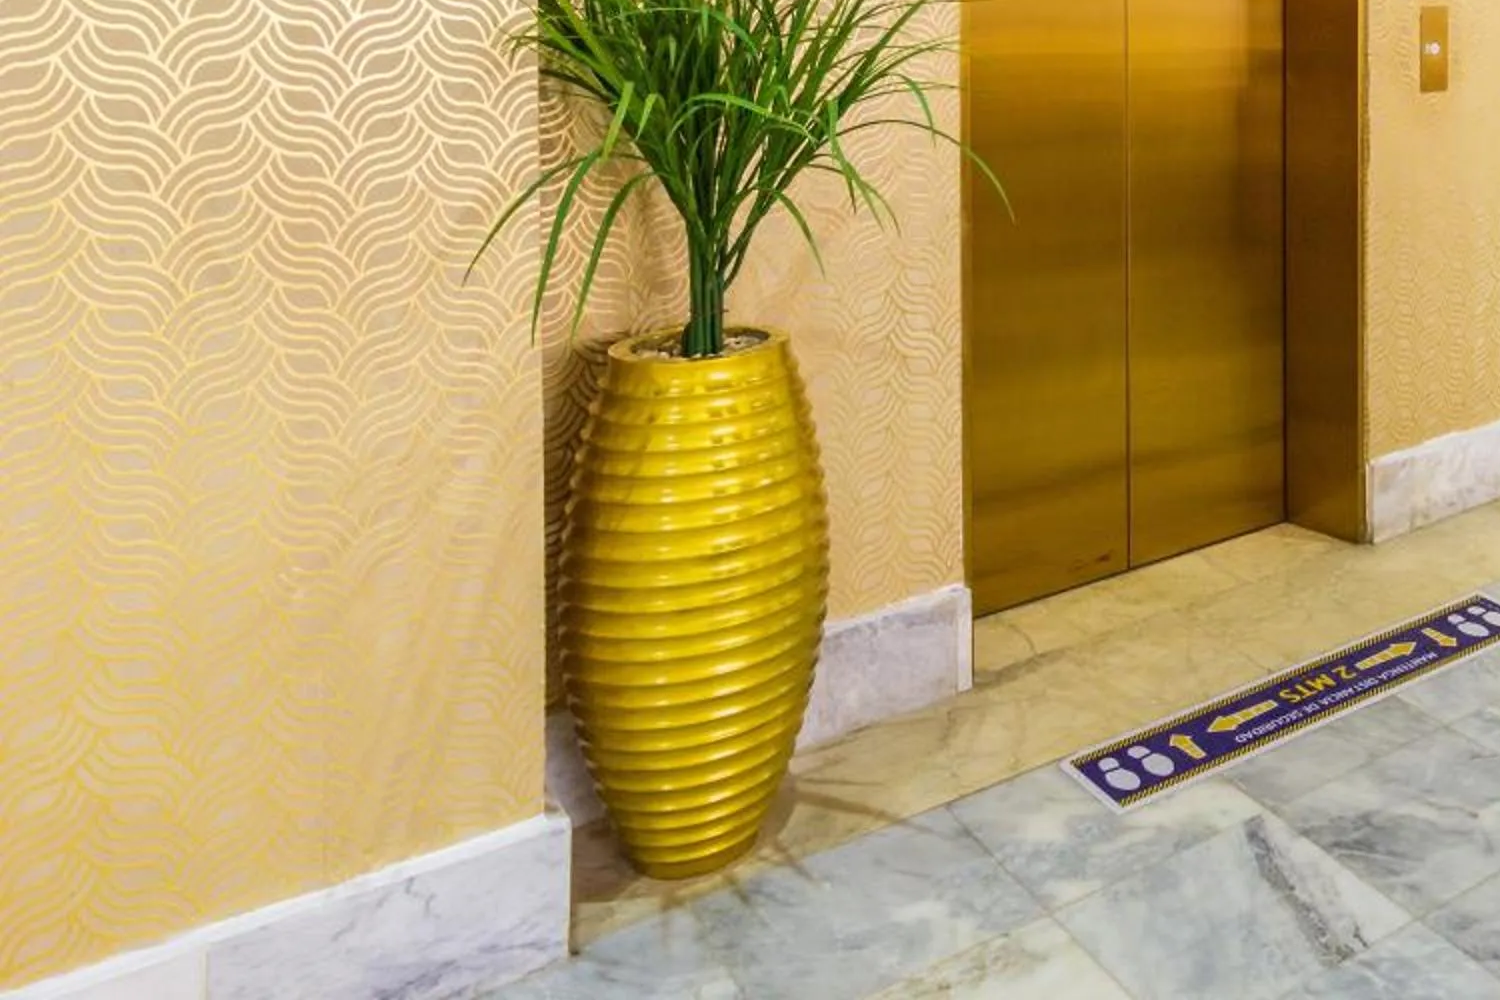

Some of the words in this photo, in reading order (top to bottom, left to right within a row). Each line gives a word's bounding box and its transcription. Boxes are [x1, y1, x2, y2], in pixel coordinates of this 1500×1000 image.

[1332, 665, 1357, 679] 2
[1279, 674, 1337, 703] MTS
[1302, 702, 1320, 714] DE
